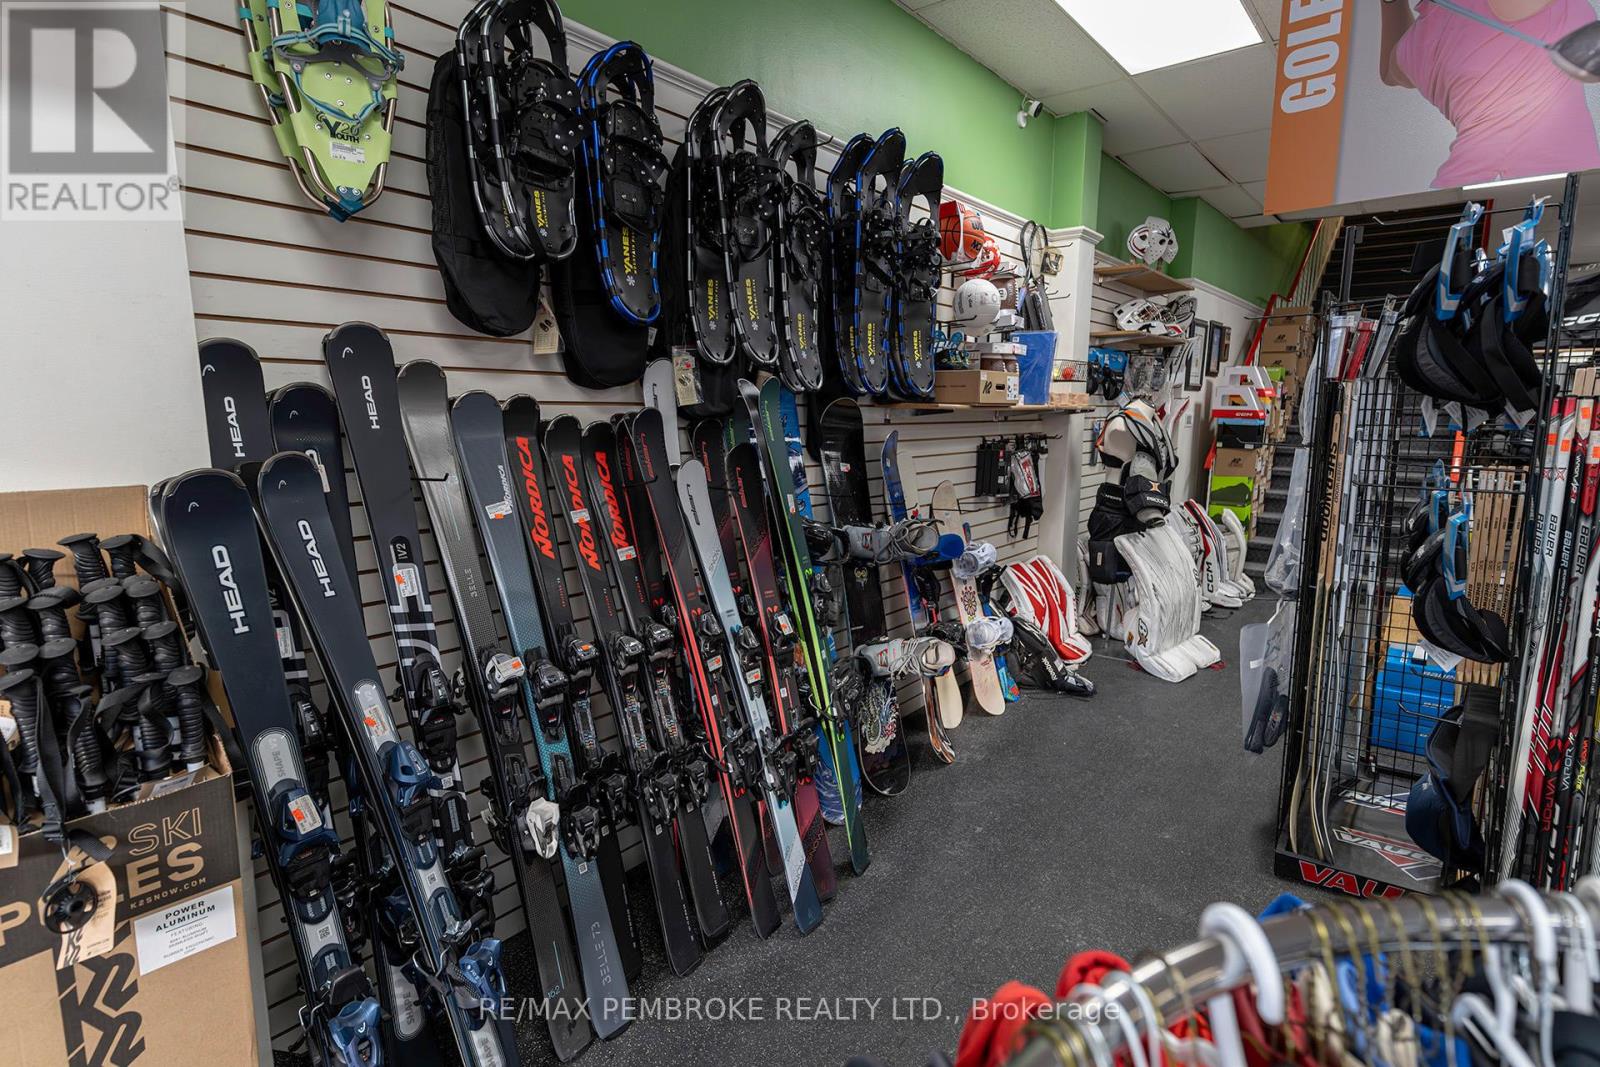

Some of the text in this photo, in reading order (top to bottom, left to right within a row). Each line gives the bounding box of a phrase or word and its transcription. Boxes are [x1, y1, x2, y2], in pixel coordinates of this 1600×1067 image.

[534, 189, 545, 227] YANES
[622, 226, 634, 274] YANES
[707, 279, 717, 320] YANES
[745, 278, 757, 320] YANES
[1561, 313, 1600, 327] CC
[361, 375, 381, 429] HEAD
[224, 396, 246, 457] HEAD
[516, 436, 556, 560] NORDICA
[298, 519, 337, 598] HEAD
[1205, 561, 1214, 593] CCM
[212, 545, 250, 635] HEAD
[1562, 746, 1575, 791] VAPOR
[1542, 777, 1557, 832] VAPOR
[128, 807, 202, 856] SKI
[129, 877, 208, 909] K2SNOW.COM
[1299, 860, 1405, 898] VAU
[155, 904, 216, 932] ALUMINUM
[164, 900, 205, 920] POWER
[402, 991, 416, 1027] SHAPE
